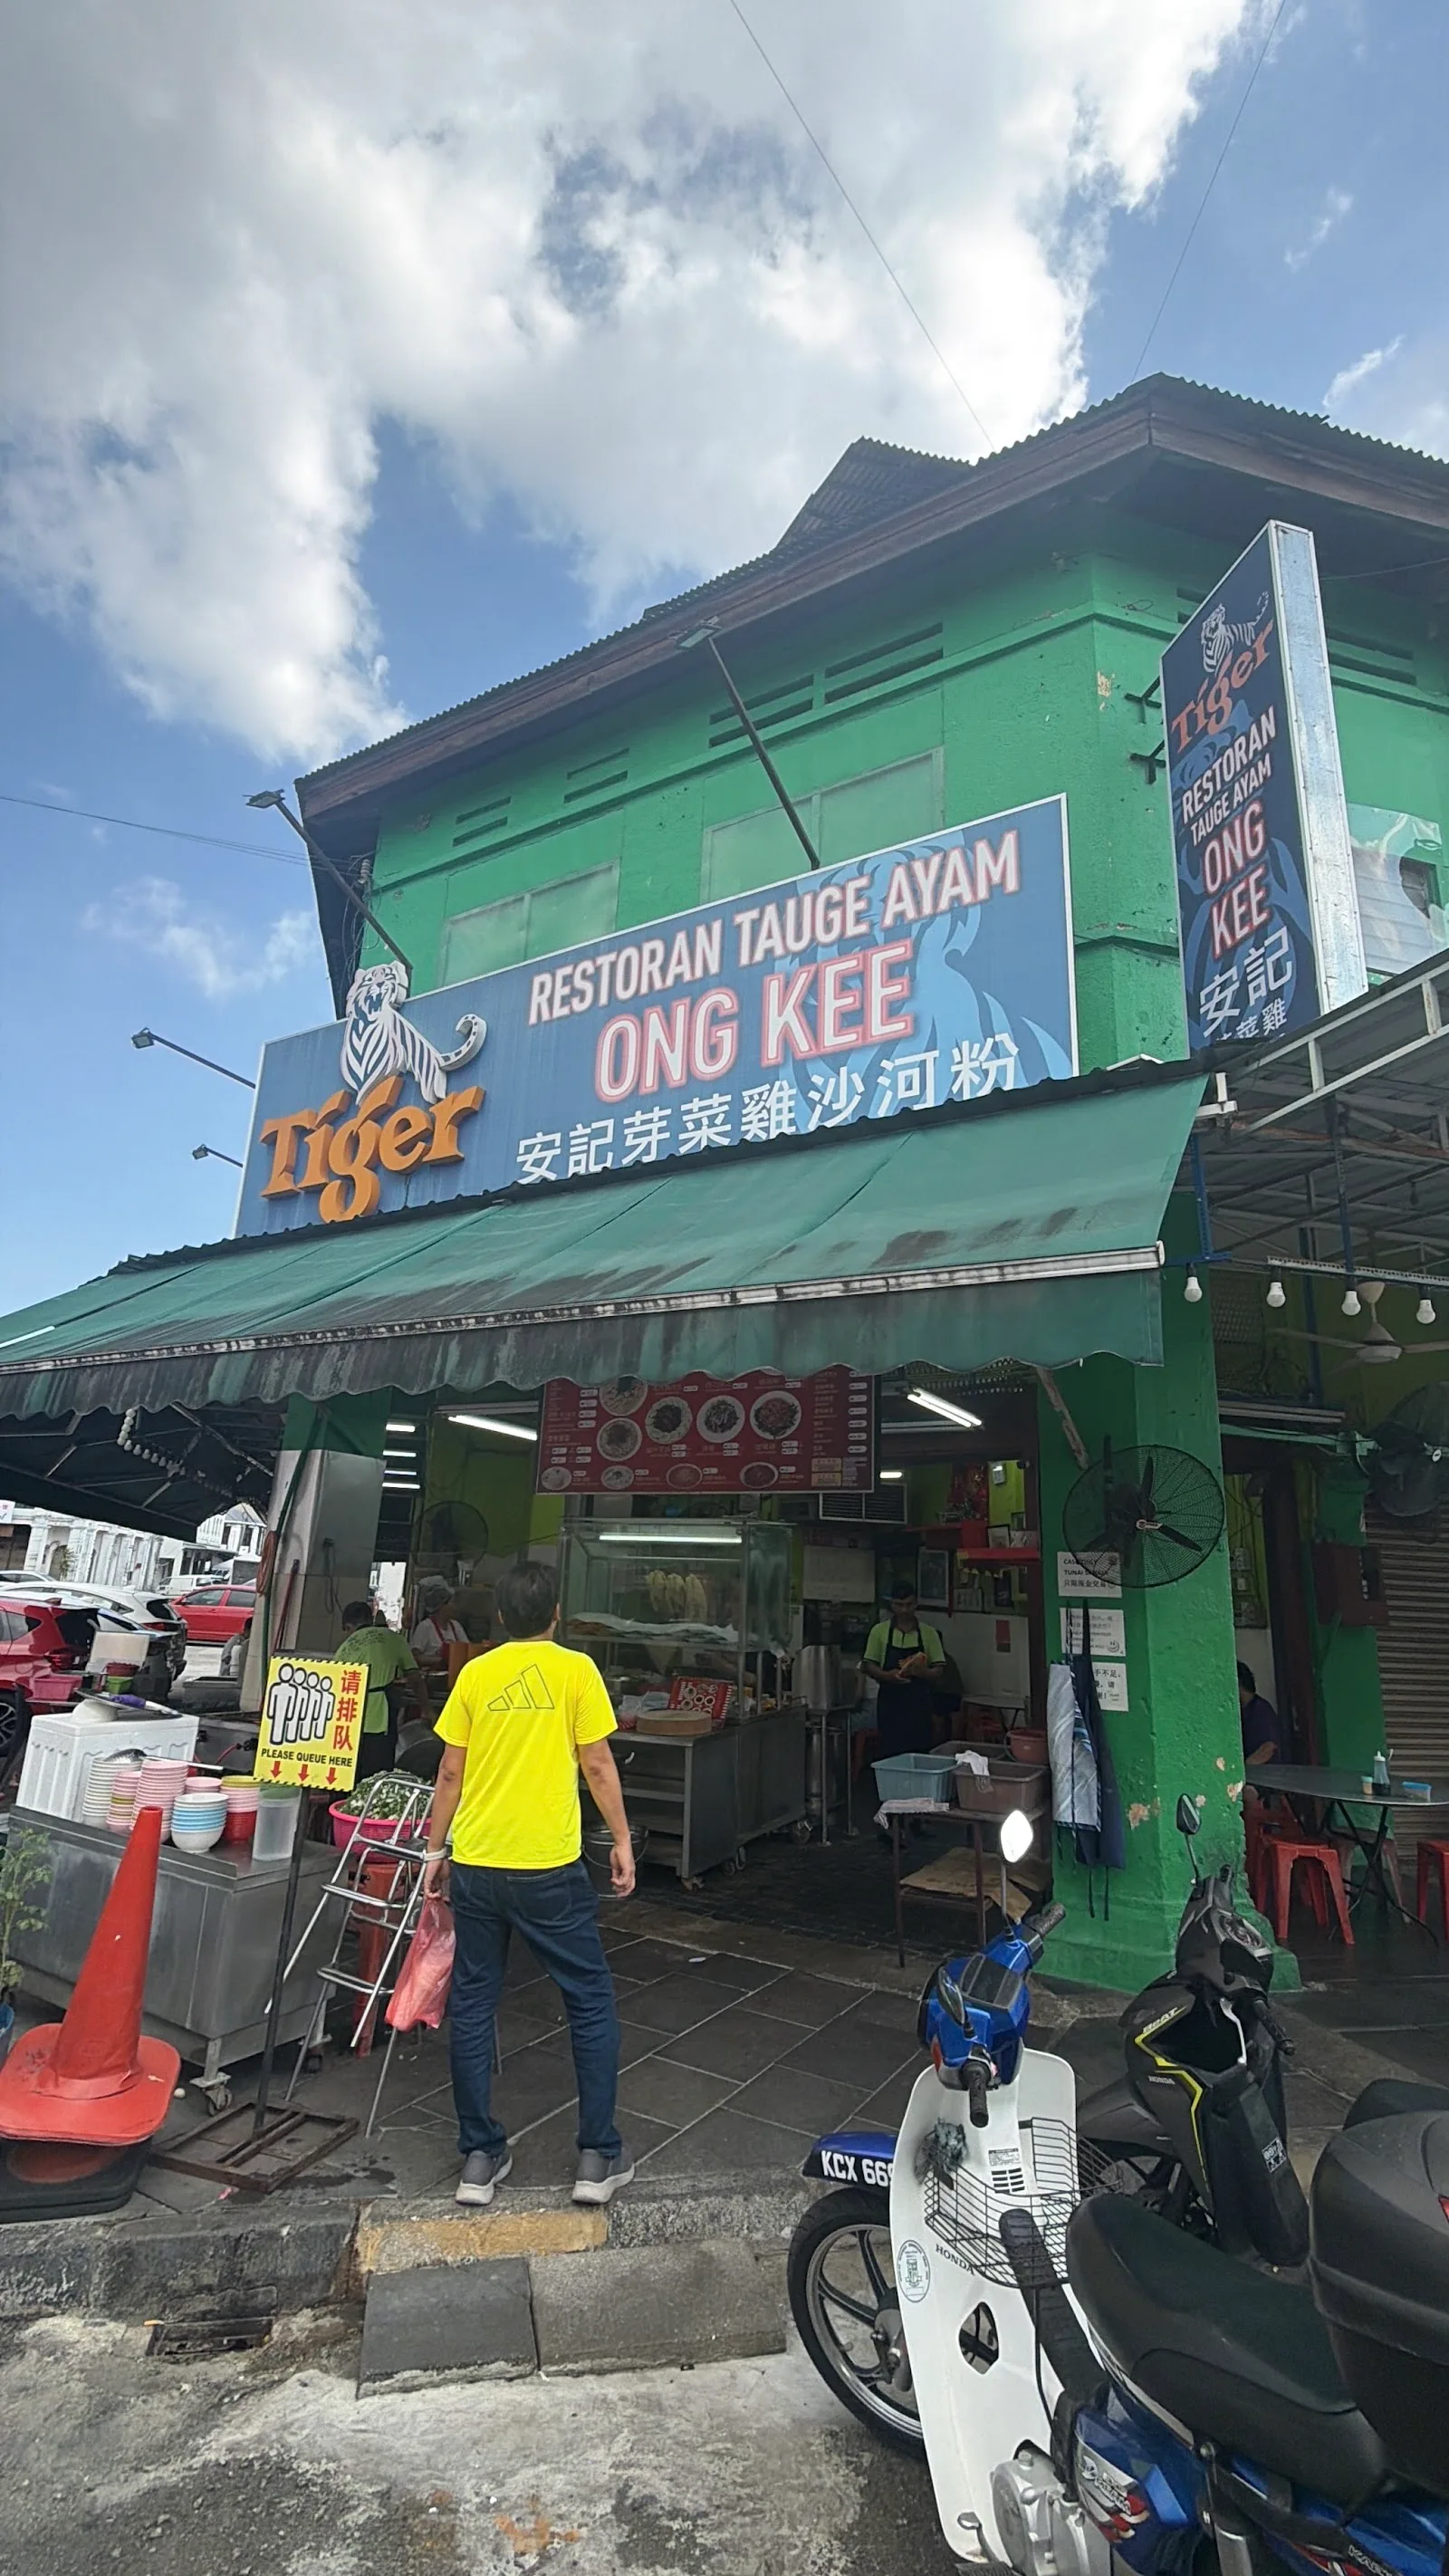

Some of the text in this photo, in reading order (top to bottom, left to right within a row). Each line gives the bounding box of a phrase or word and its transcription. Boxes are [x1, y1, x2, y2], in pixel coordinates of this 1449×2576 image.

[1171, 619, 1273, 754] Tiger
[1182, 705, 1276, 824] RESTORAN
[1191, 753, 1271, 847] TAUGE AYAM
[1203, 800, 1265, 895] ONG
[529, 828, 1021, 1026] RESTORAN TAUGE AYAM
[1211, 863, 1270, 960] KEE
[595, 937, 915, 1102] ONG KEE
[1200, 926, 1291, 1038] 安記
[260, 1075, 485, 1223] Tiger
[516, 1033, 1020, 1184] 安記芽菜雞沙河粉
[261, 1748, 353, 1767] PLEASE QUEUE HERE
[333, 1670, 361, 1752] 请排队
[821, 2150, 858, 2183] KCX
[936, 2244, 975, 2276] HONDA
